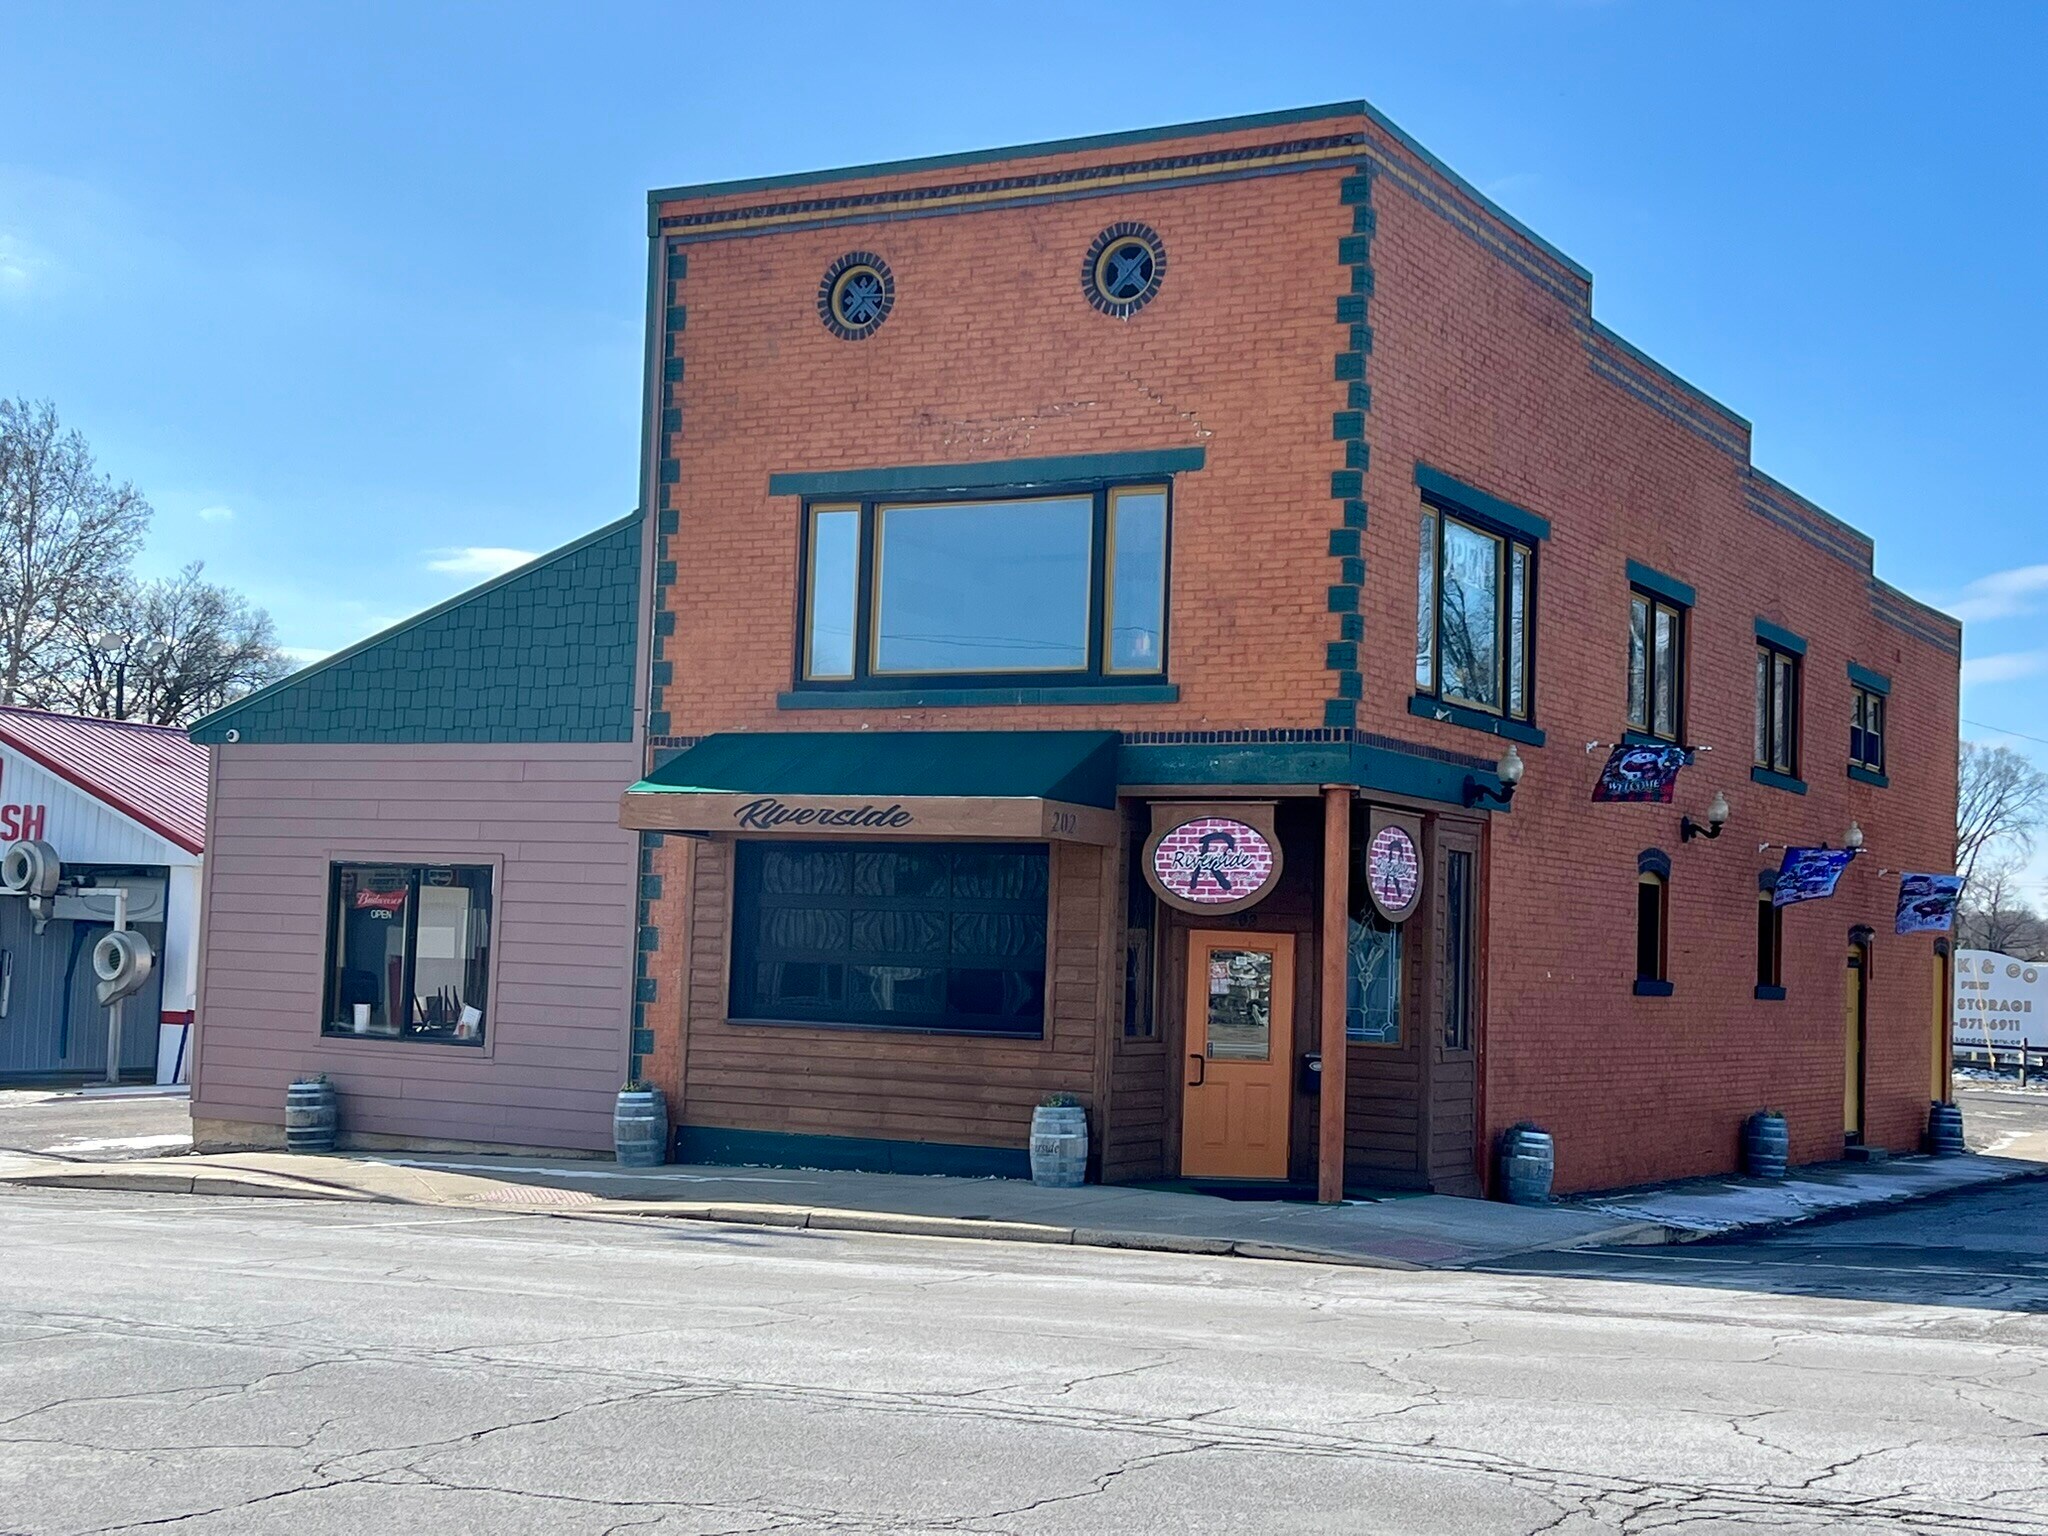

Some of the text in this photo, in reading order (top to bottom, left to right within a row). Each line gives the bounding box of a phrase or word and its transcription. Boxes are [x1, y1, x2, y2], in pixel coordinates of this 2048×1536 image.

[734, 798, 914, 829] Riverside
[1051, 811, 1077, 835] 202
[1172, 847, 1253, 871] Riverside
[1190, 832, 1235, 890] R
[370, 909, 393, 919] OPEN
[1957, 998, 2032, 1013] STORAGE
